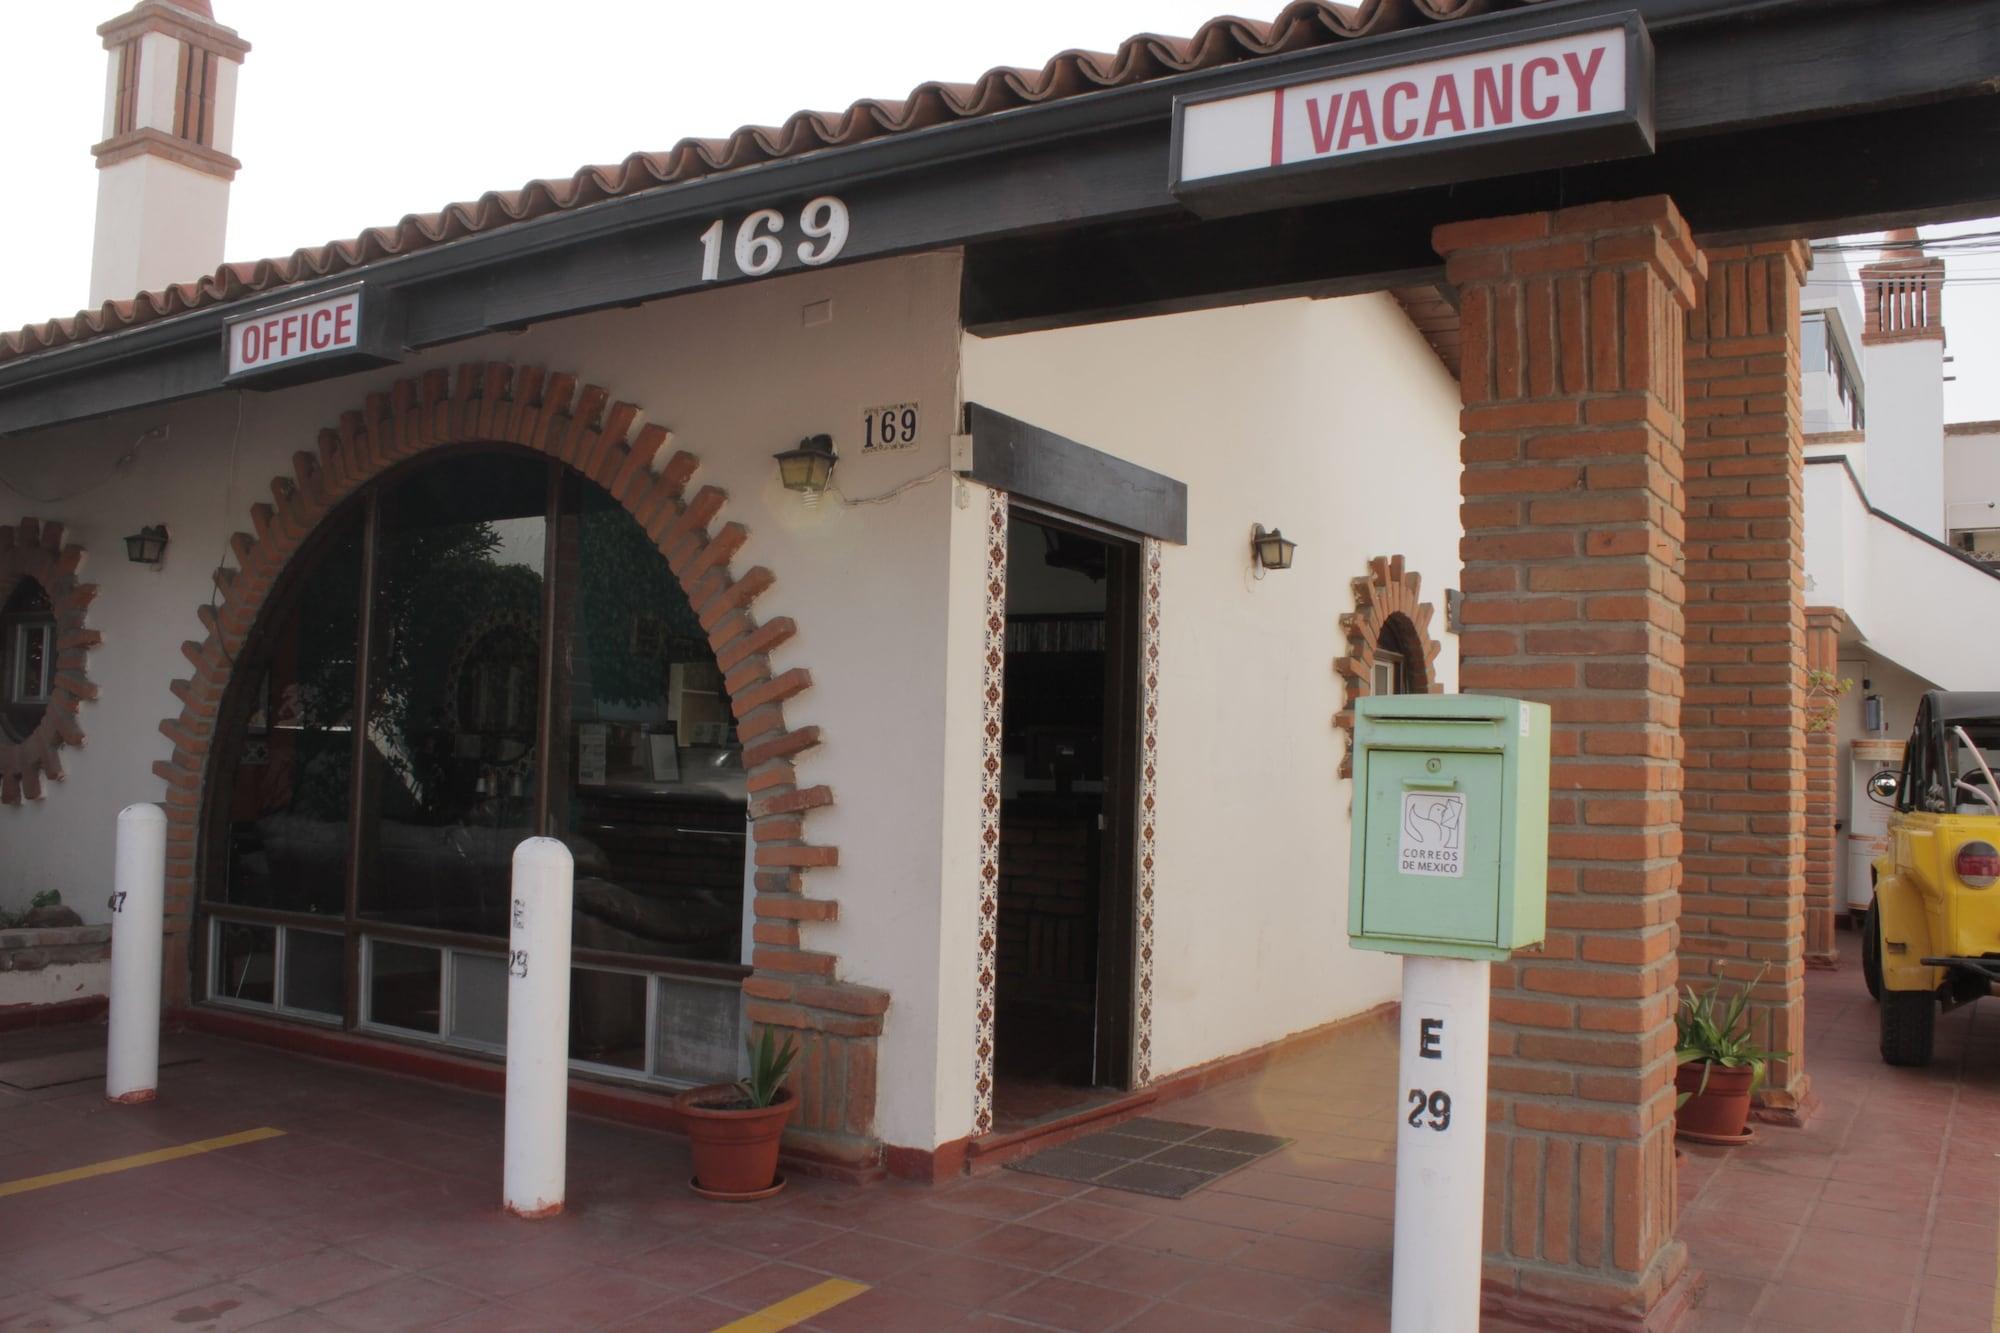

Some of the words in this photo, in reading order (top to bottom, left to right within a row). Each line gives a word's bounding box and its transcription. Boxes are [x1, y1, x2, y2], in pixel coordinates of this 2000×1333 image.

[1305, 46, 1606, 154] VACANCY
[700, 195, 850, 281] 169
[241, 303, 353, 364] OFFICE
[864, 408, 917, 448] 169
[1402, 848, 1459, 861] CORREOS
[1402, 860, 1415, 870] DE
[1417, 861, 1458, 874] MEXICO
[1419, 1018, 1443, 1060] E
[1408, 1088, 1452, 1132] 29
